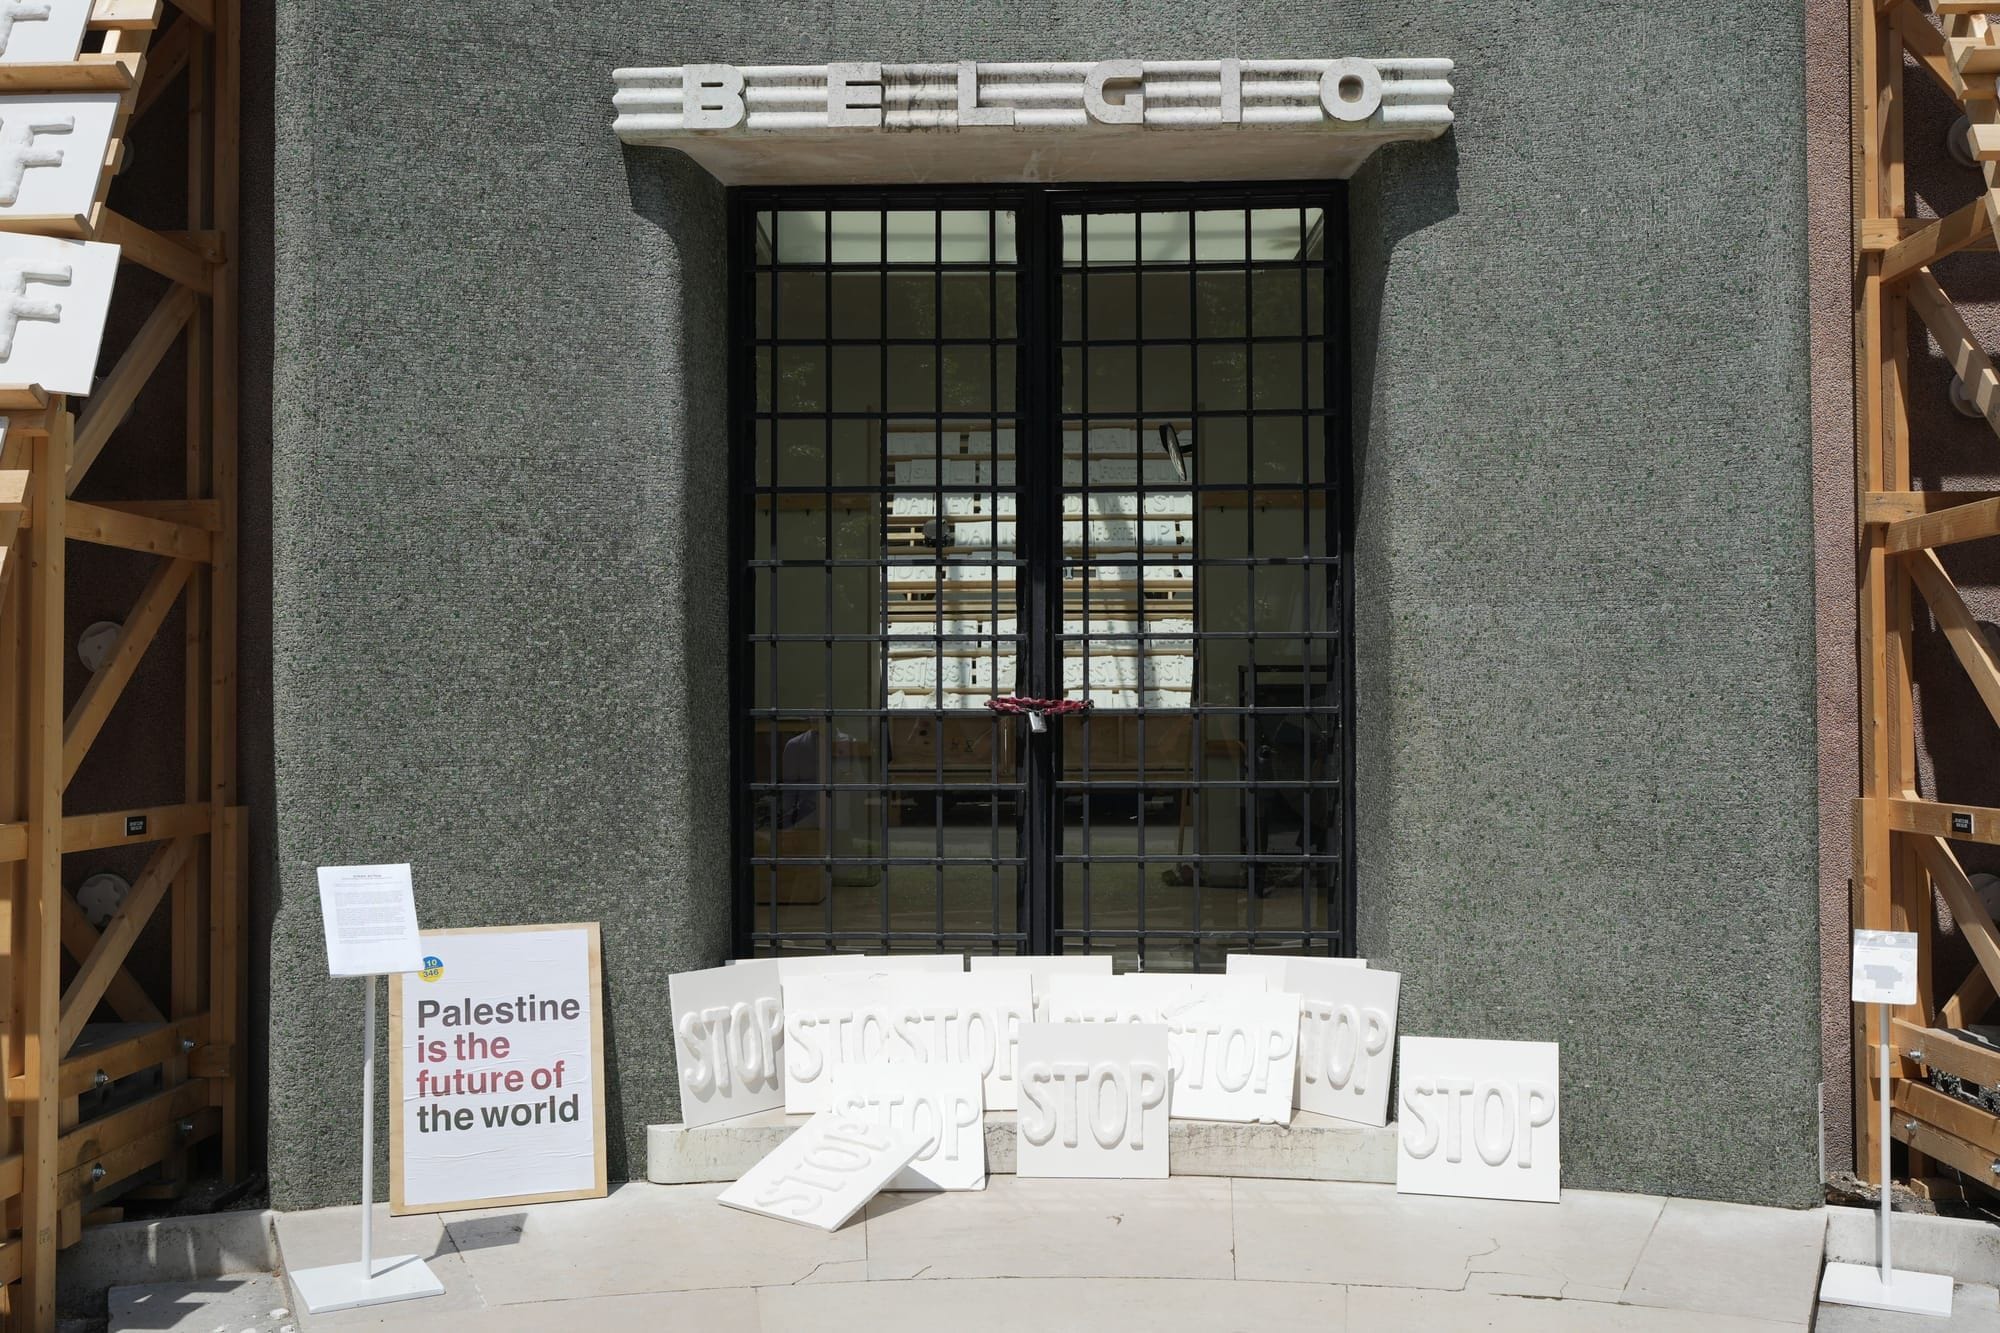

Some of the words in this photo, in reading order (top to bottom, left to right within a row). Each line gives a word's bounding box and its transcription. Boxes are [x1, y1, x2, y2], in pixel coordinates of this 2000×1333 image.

[683, 57, 1383, 129] BELGIO
[417, 994, 580, 1028] Palestine
[680, 997, 784, 1089] STOP
[788, 1010, 888, 1083] STO
[417, 1035, 447, 1063] is
[454, 1032, 510, 1060] the
[417, 1068, 524, 1098] future
[531, 1060, 565, 1089] of
[1300, 1001, 1389, 1095] TOP
[417, 1104, 474, 1133] the
[481, 1093, 579, 1128] world
[1020, 1061, 1166, 1150] STOP
[1403, 1076, 1555, 1168] STOP
